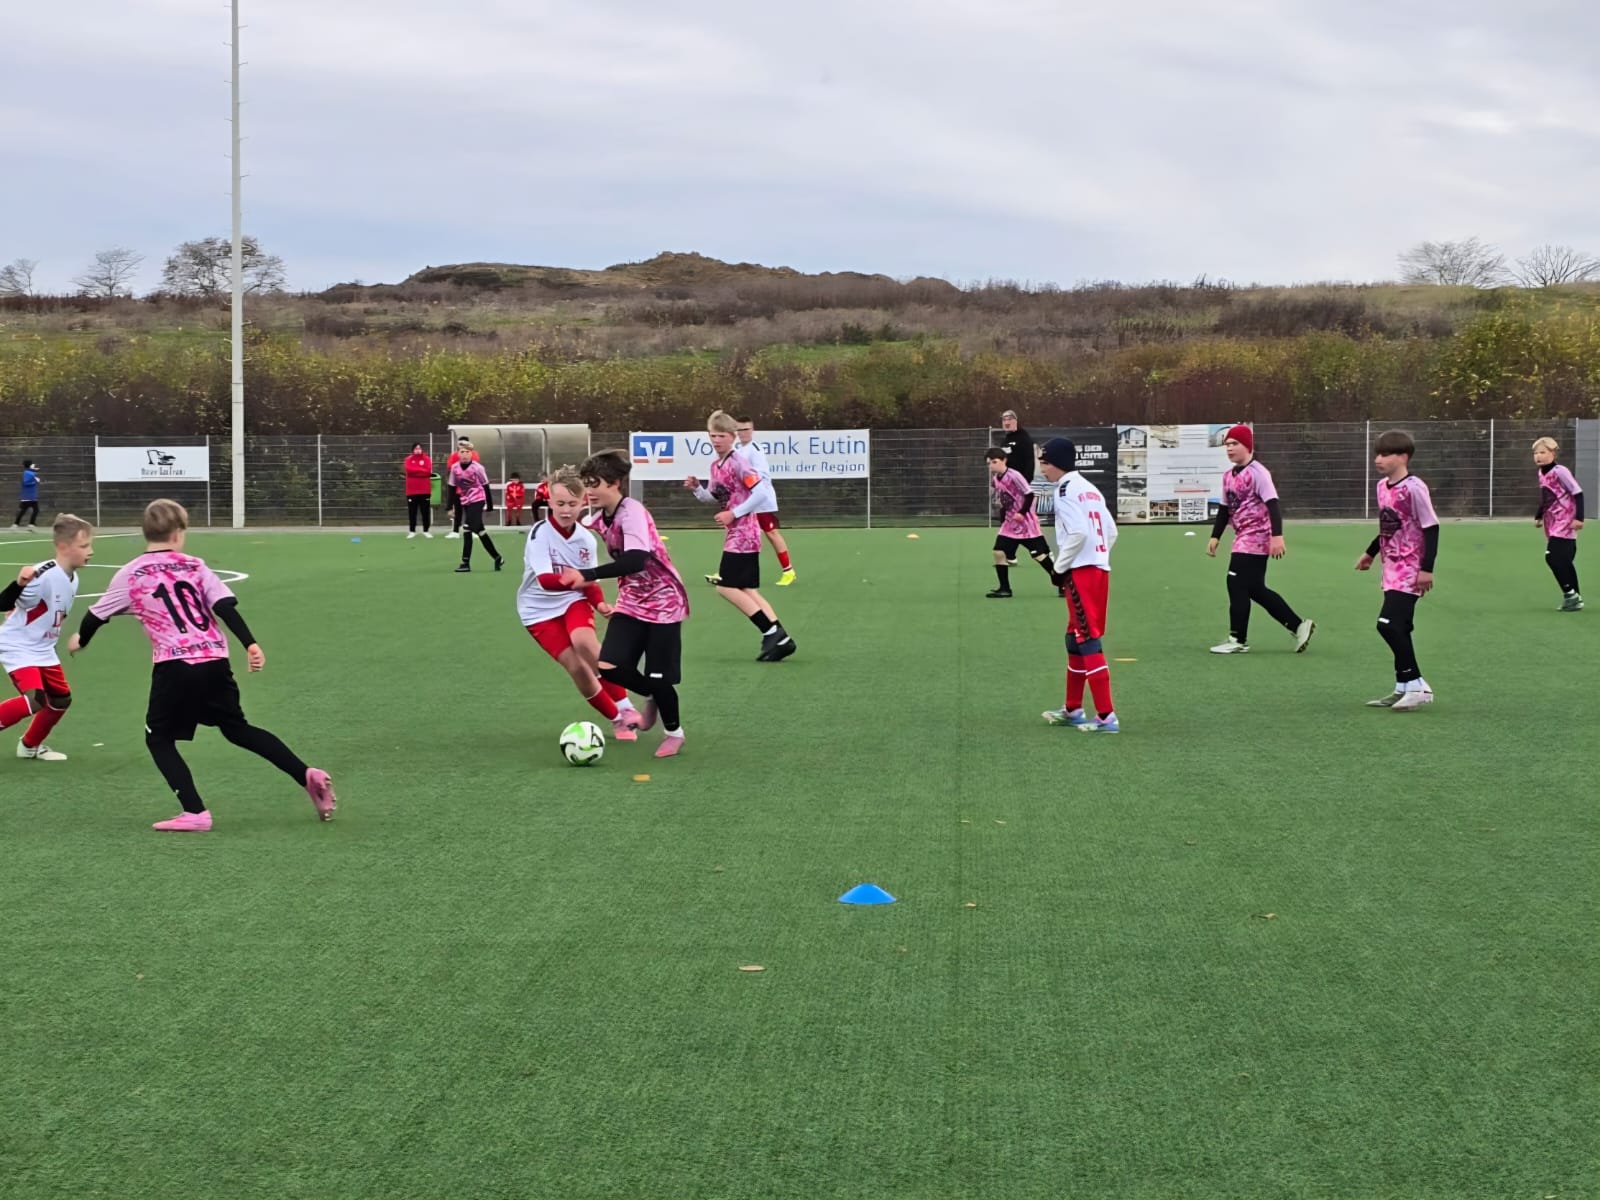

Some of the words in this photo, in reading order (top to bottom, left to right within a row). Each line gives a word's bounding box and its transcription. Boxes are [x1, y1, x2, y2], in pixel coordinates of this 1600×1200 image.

[809, 435, 866, 455] Eutin
[796, 461, 816, 473] der
[821, 461, 865, 475] Region
[152, 581, 210, 634] 10
